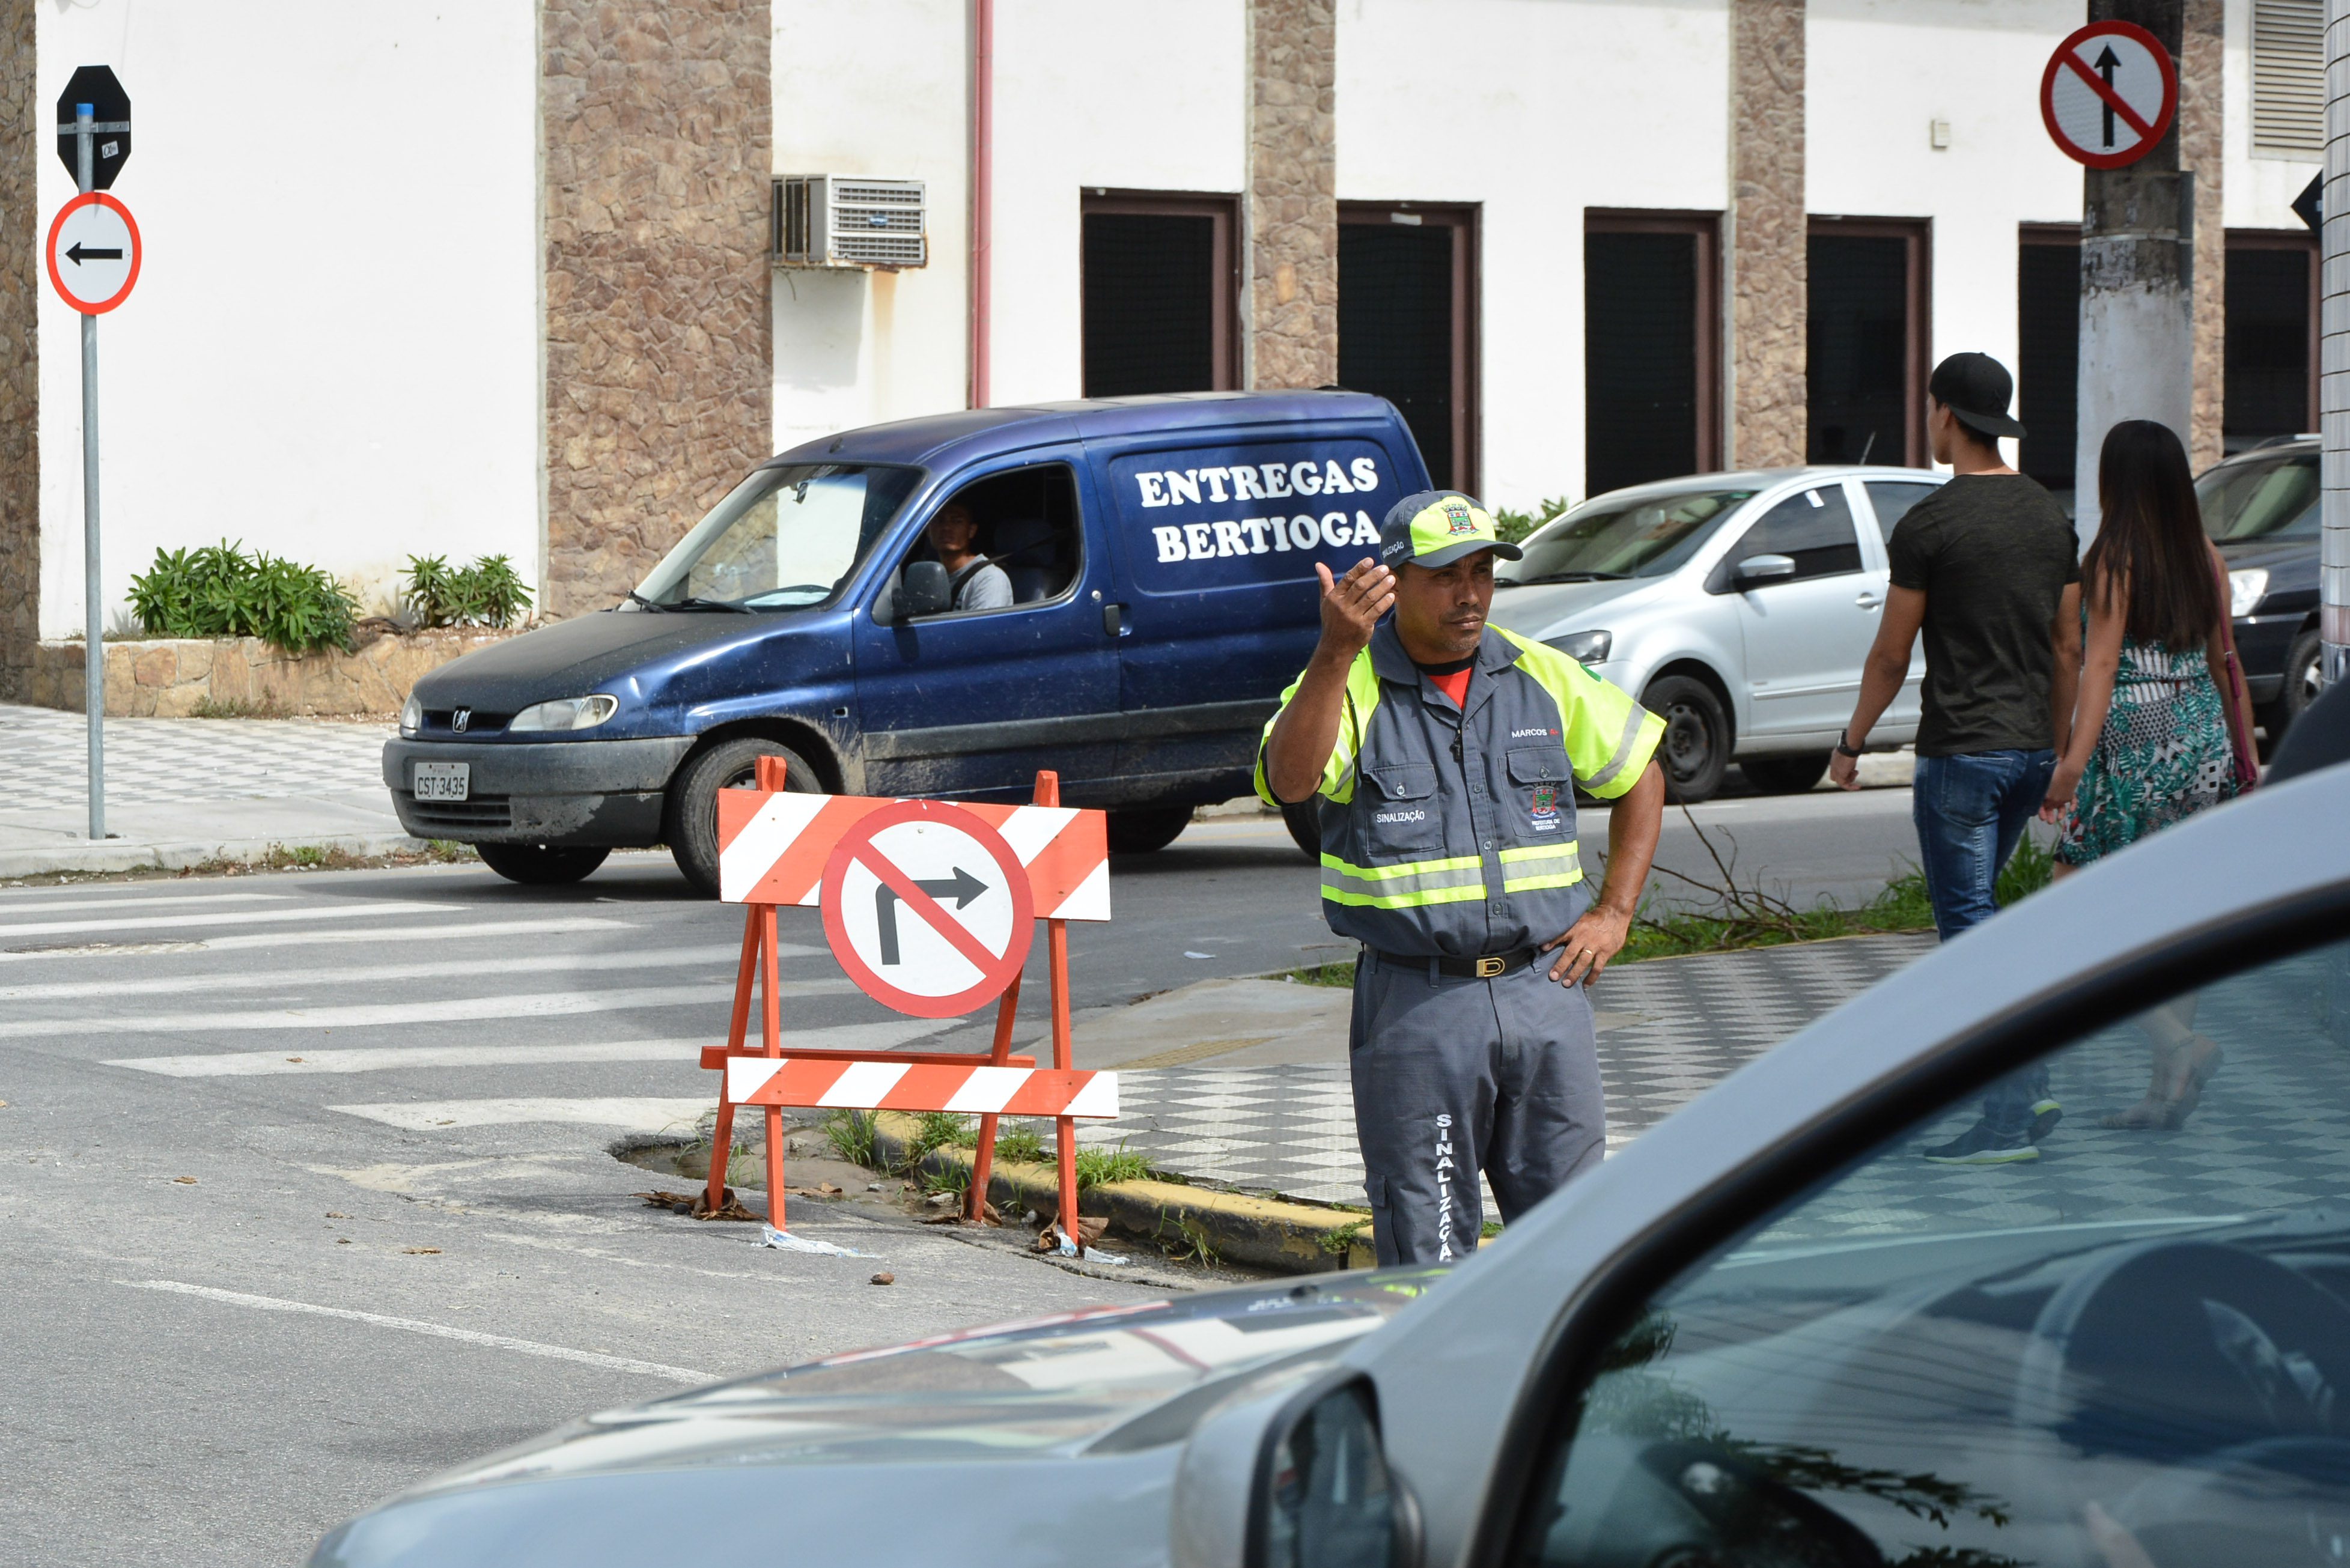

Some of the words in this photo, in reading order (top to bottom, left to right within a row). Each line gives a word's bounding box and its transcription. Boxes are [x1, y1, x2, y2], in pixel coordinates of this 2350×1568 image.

[1135, 457, 1378, 508] ENTREGAS
[1152, 509, 1381, 562] BERTIOGA
[1511, 728, 1547, 738] MARCOS
[1377, 810, 1425, 823] SINALIZAÇÃO
